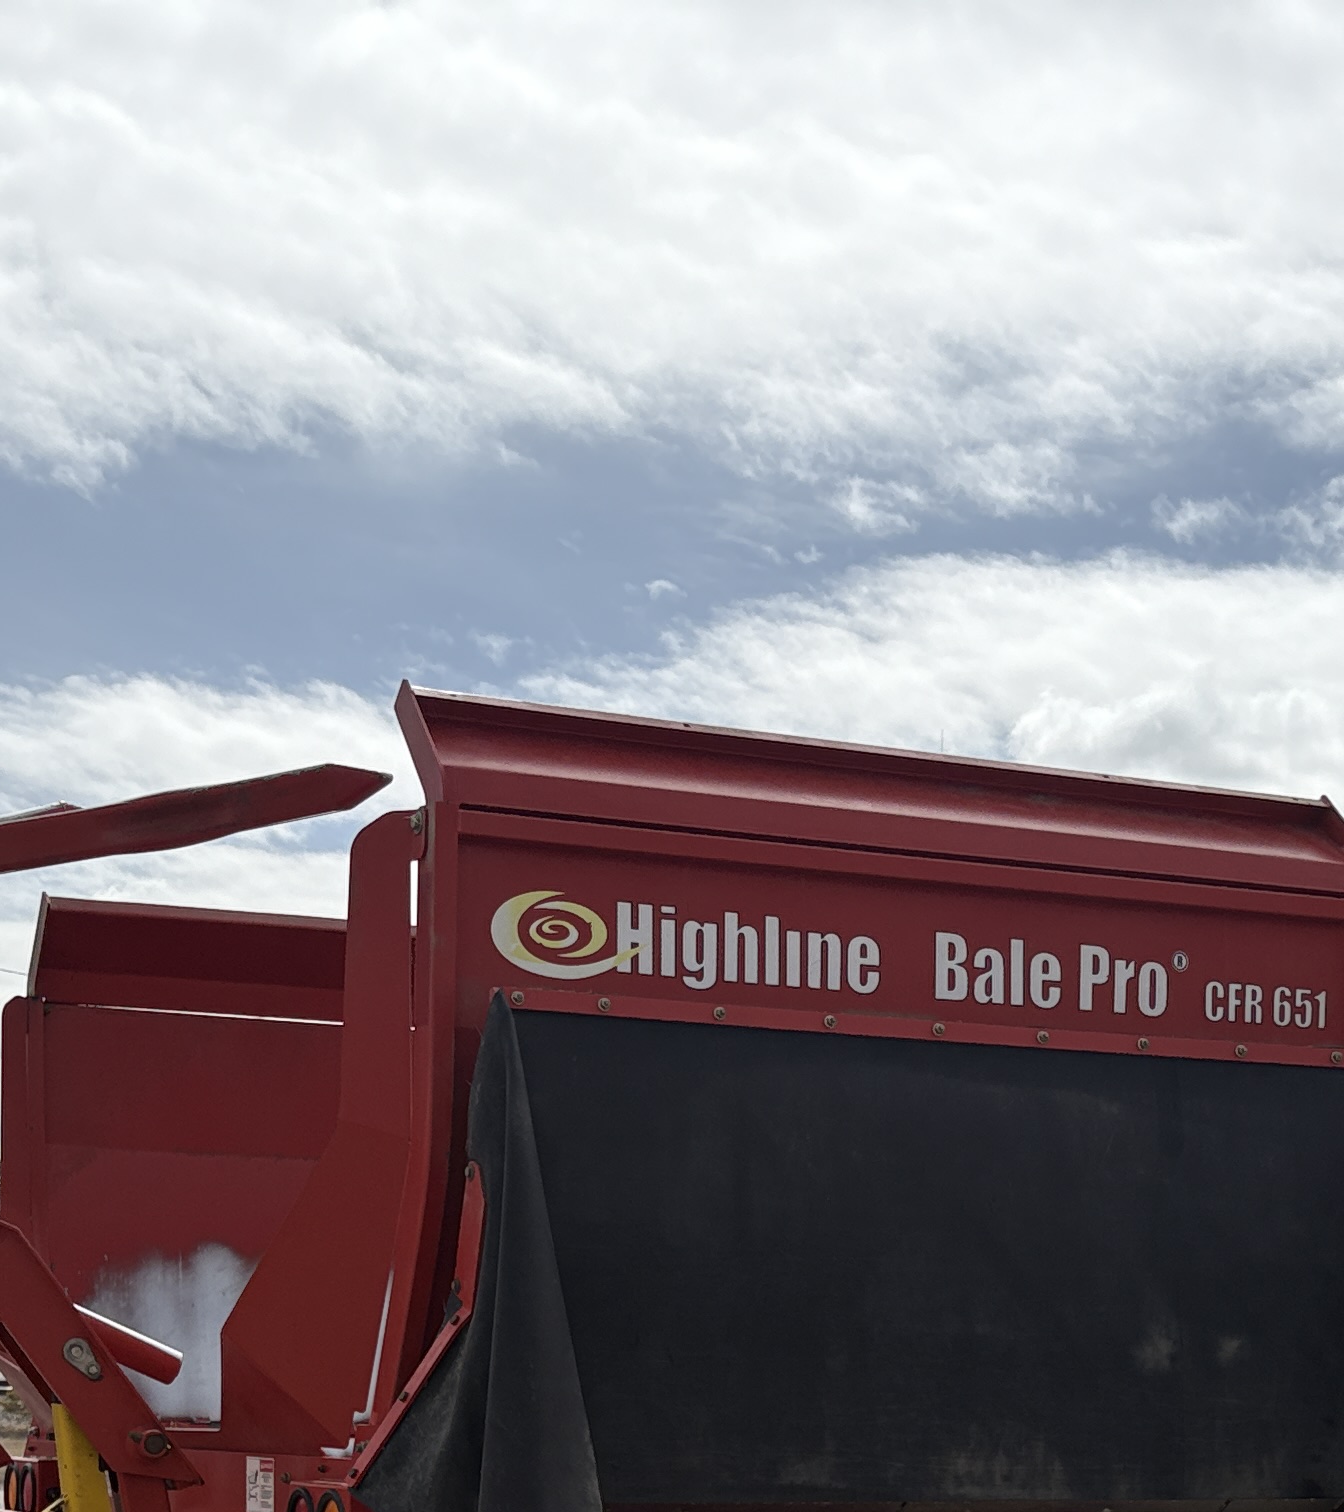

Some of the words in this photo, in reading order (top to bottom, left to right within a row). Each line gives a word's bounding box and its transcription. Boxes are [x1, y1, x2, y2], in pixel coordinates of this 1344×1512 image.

[615, 901, 881, 992] Highline
[934, 931, 1062, 1010] Bale
[1205, 980, 1263, 1024] CFR
[1273, 986, 1327, 1029] 651
